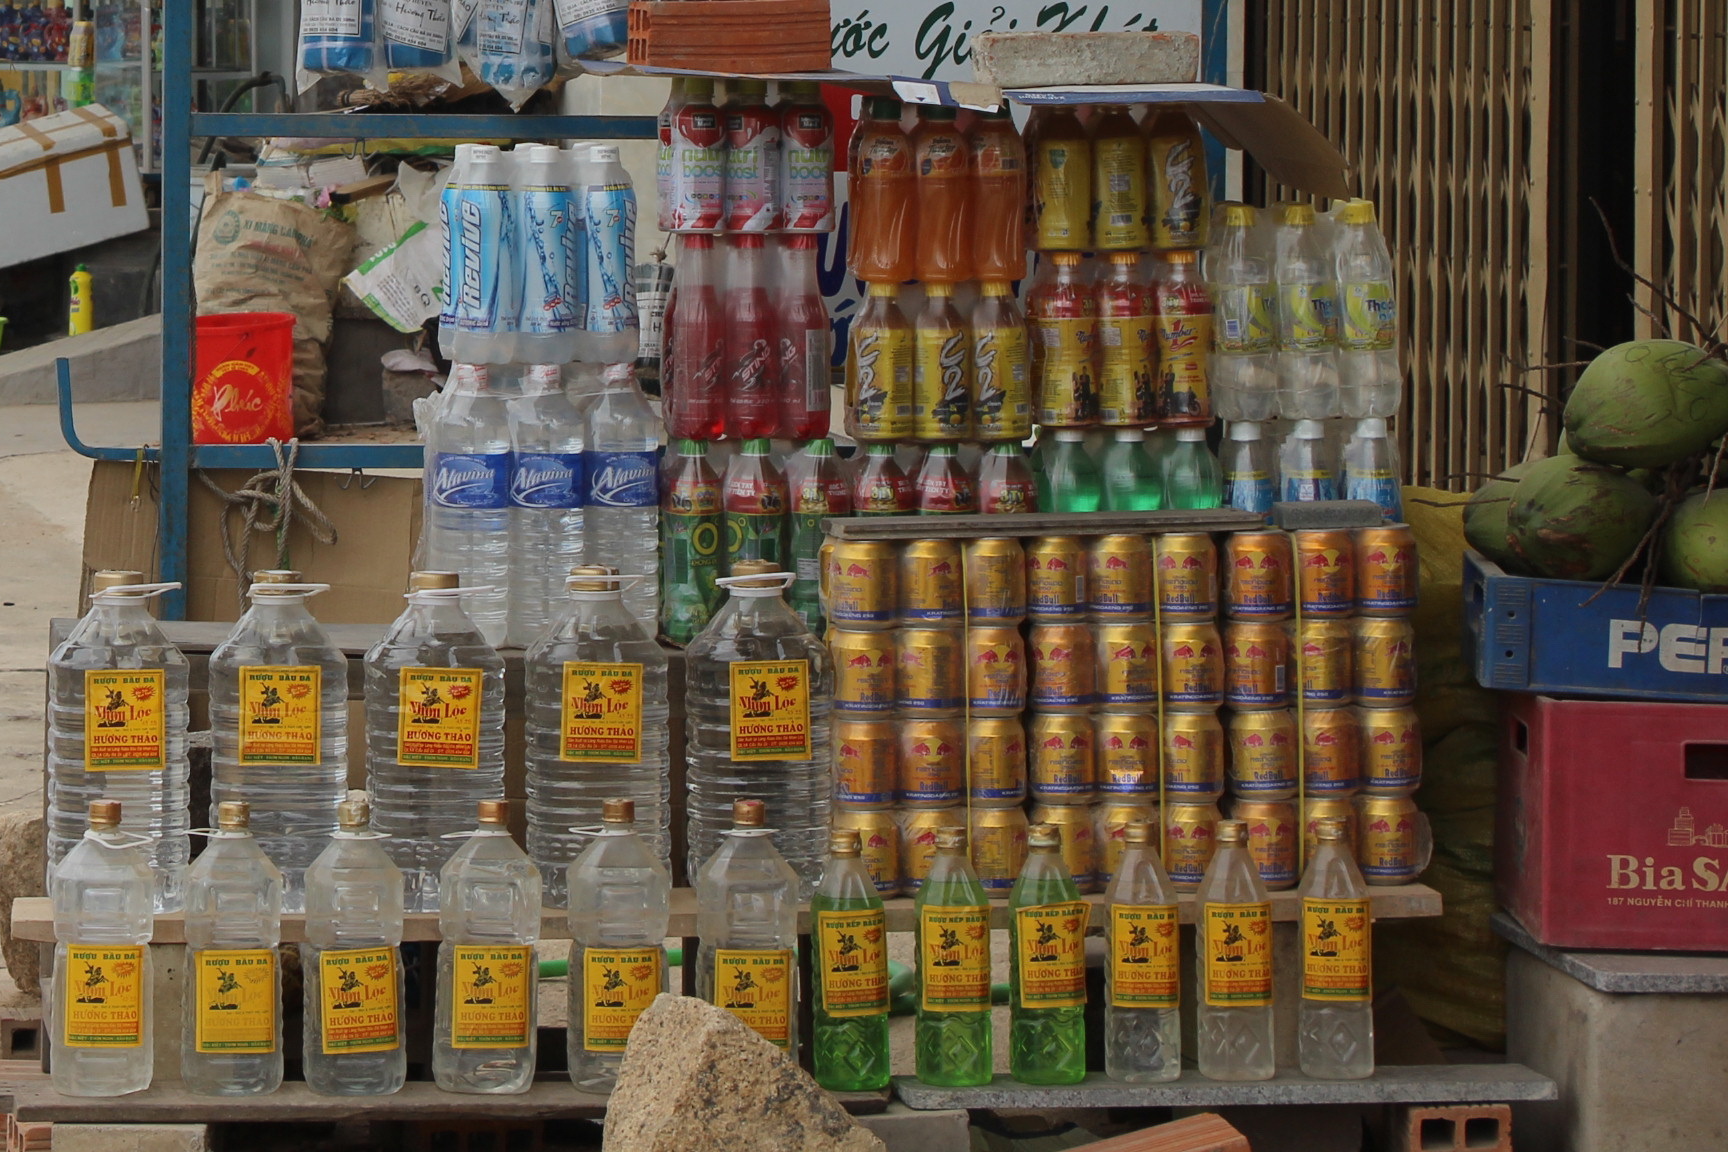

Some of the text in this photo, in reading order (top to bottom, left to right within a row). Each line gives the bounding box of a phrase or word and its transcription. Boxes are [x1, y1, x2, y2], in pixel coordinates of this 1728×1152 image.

[831, 9, 890, 58] ước
[462, 200, 482, 311] Revive
[93, 731, 158, 744] HƯƠNG THẢO
[1606, 854, 1728, 891] Bia S
[1607, 897, 1623, 905] 187
[1627, 894, 1671, 907] NGUYỄN
[73, 1008, 137, 1020] HƯƠNG THẢO
[330, 1010, 393, 1026] HƯƠNG THẢO
